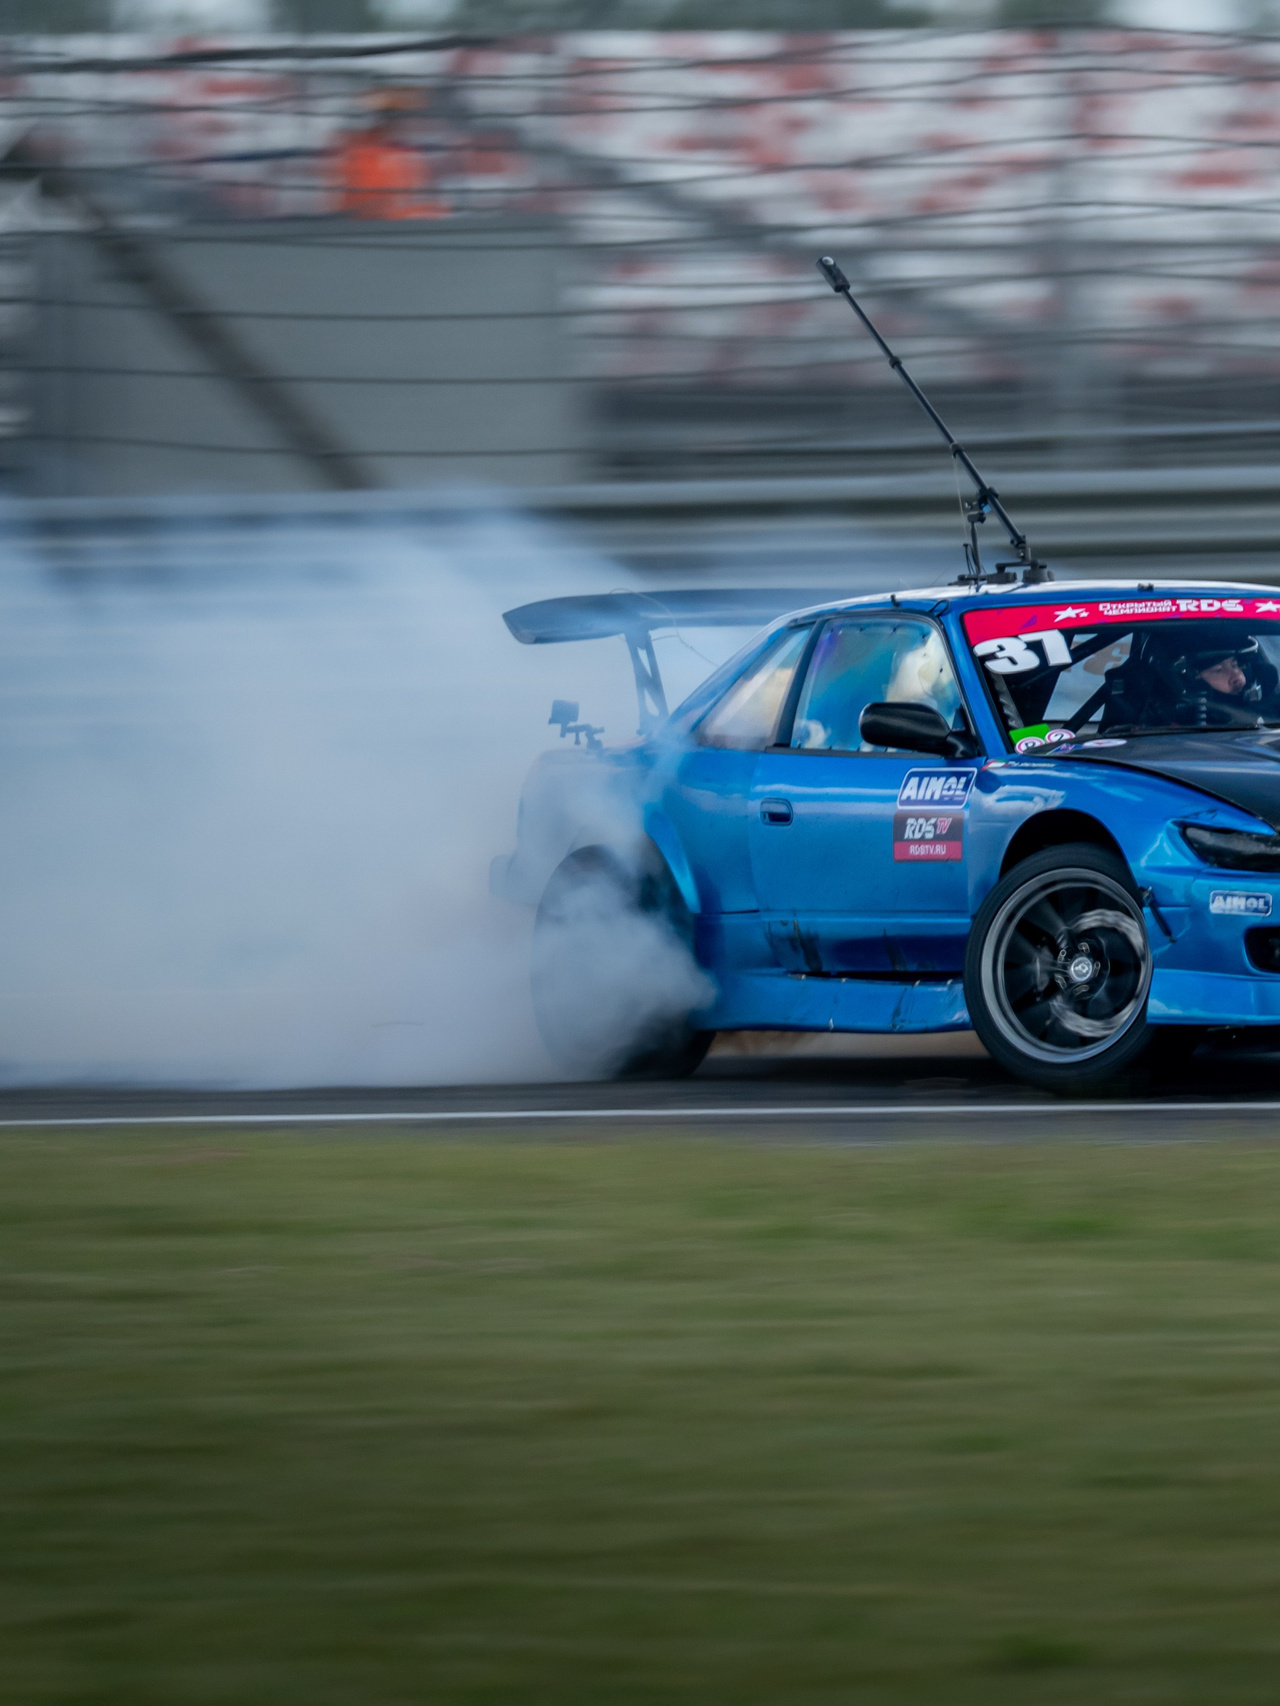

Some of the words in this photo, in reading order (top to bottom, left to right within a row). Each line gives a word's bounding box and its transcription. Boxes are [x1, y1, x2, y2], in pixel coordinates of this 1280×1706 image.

[1176, 599, 1244, 612] RDS
[973, 629, 1072, 675] 37
[900, 776, 967, 800] AIMOL
[1211, 895, 1268, 910] AIMOL
